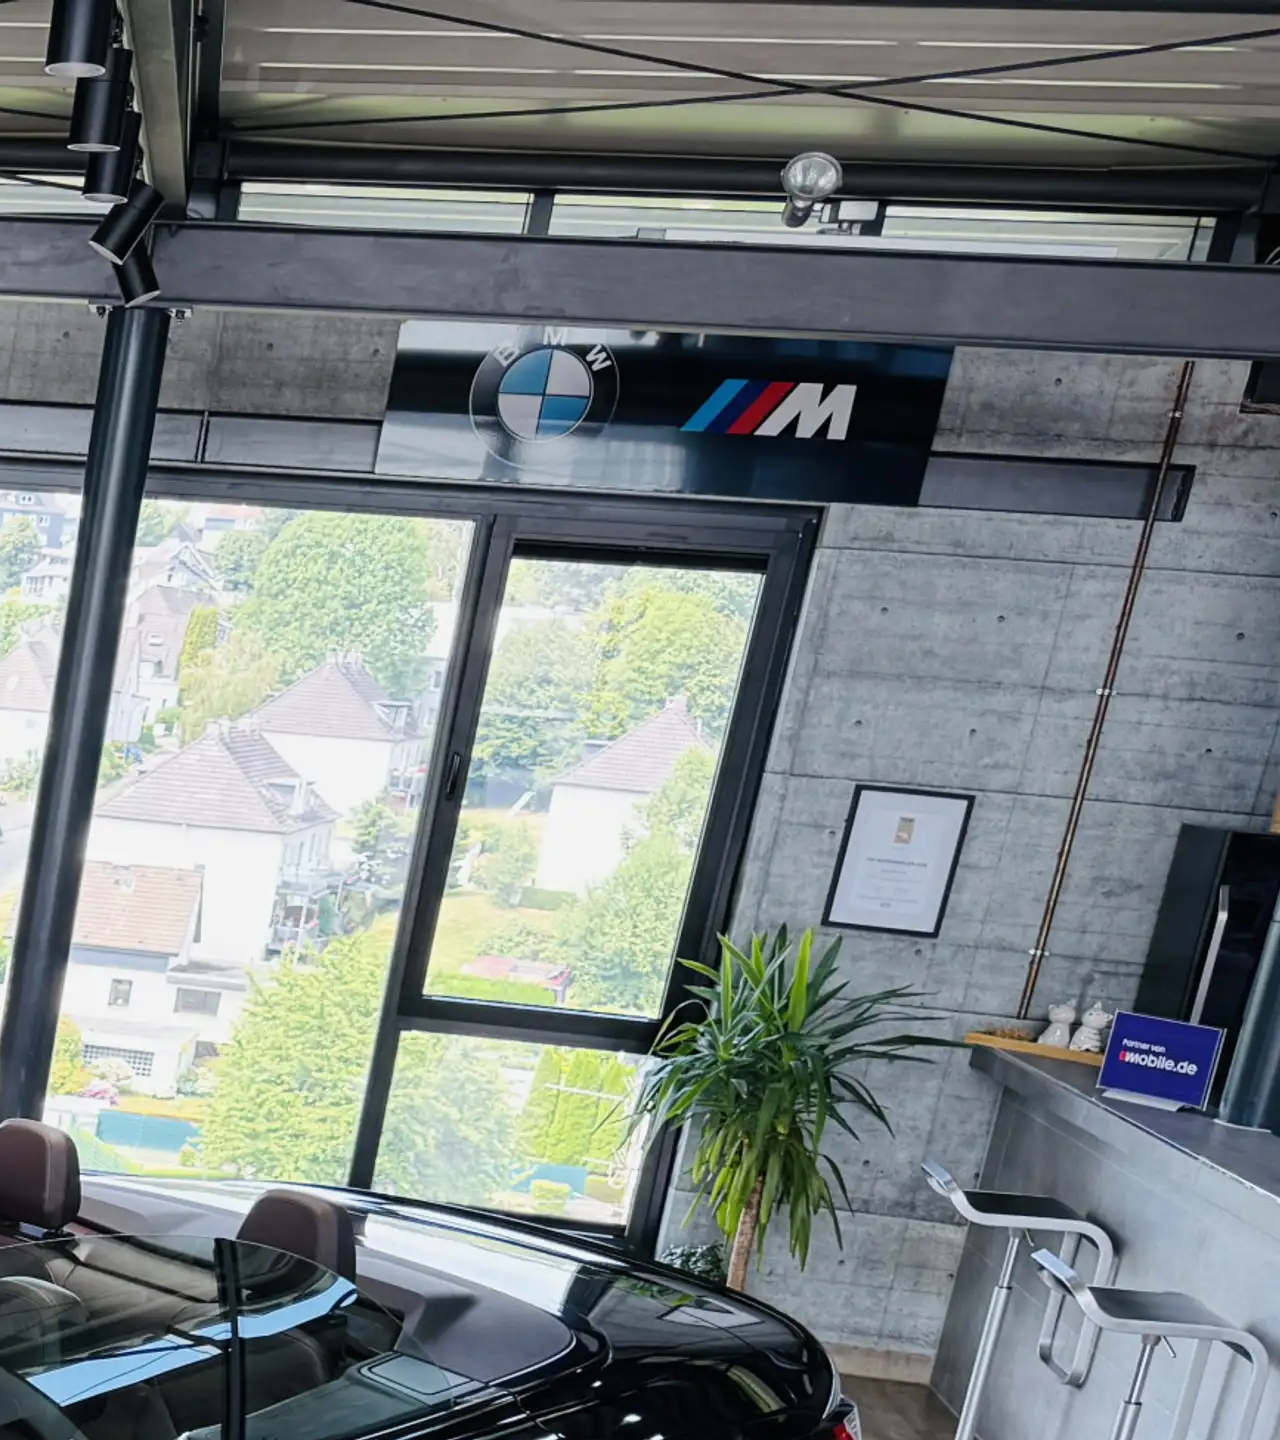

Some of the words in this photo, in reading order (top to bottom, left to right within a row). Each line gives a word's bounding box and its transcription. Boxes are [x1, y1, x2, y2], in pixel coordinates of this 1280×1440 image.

[492, 325, 613, 373] BMW
[1121, 1038, 1151, 1051] Partner
[1151, 1043, 1167, 1054] von
[1124, 1051, 1199, 1076] mobile.de
